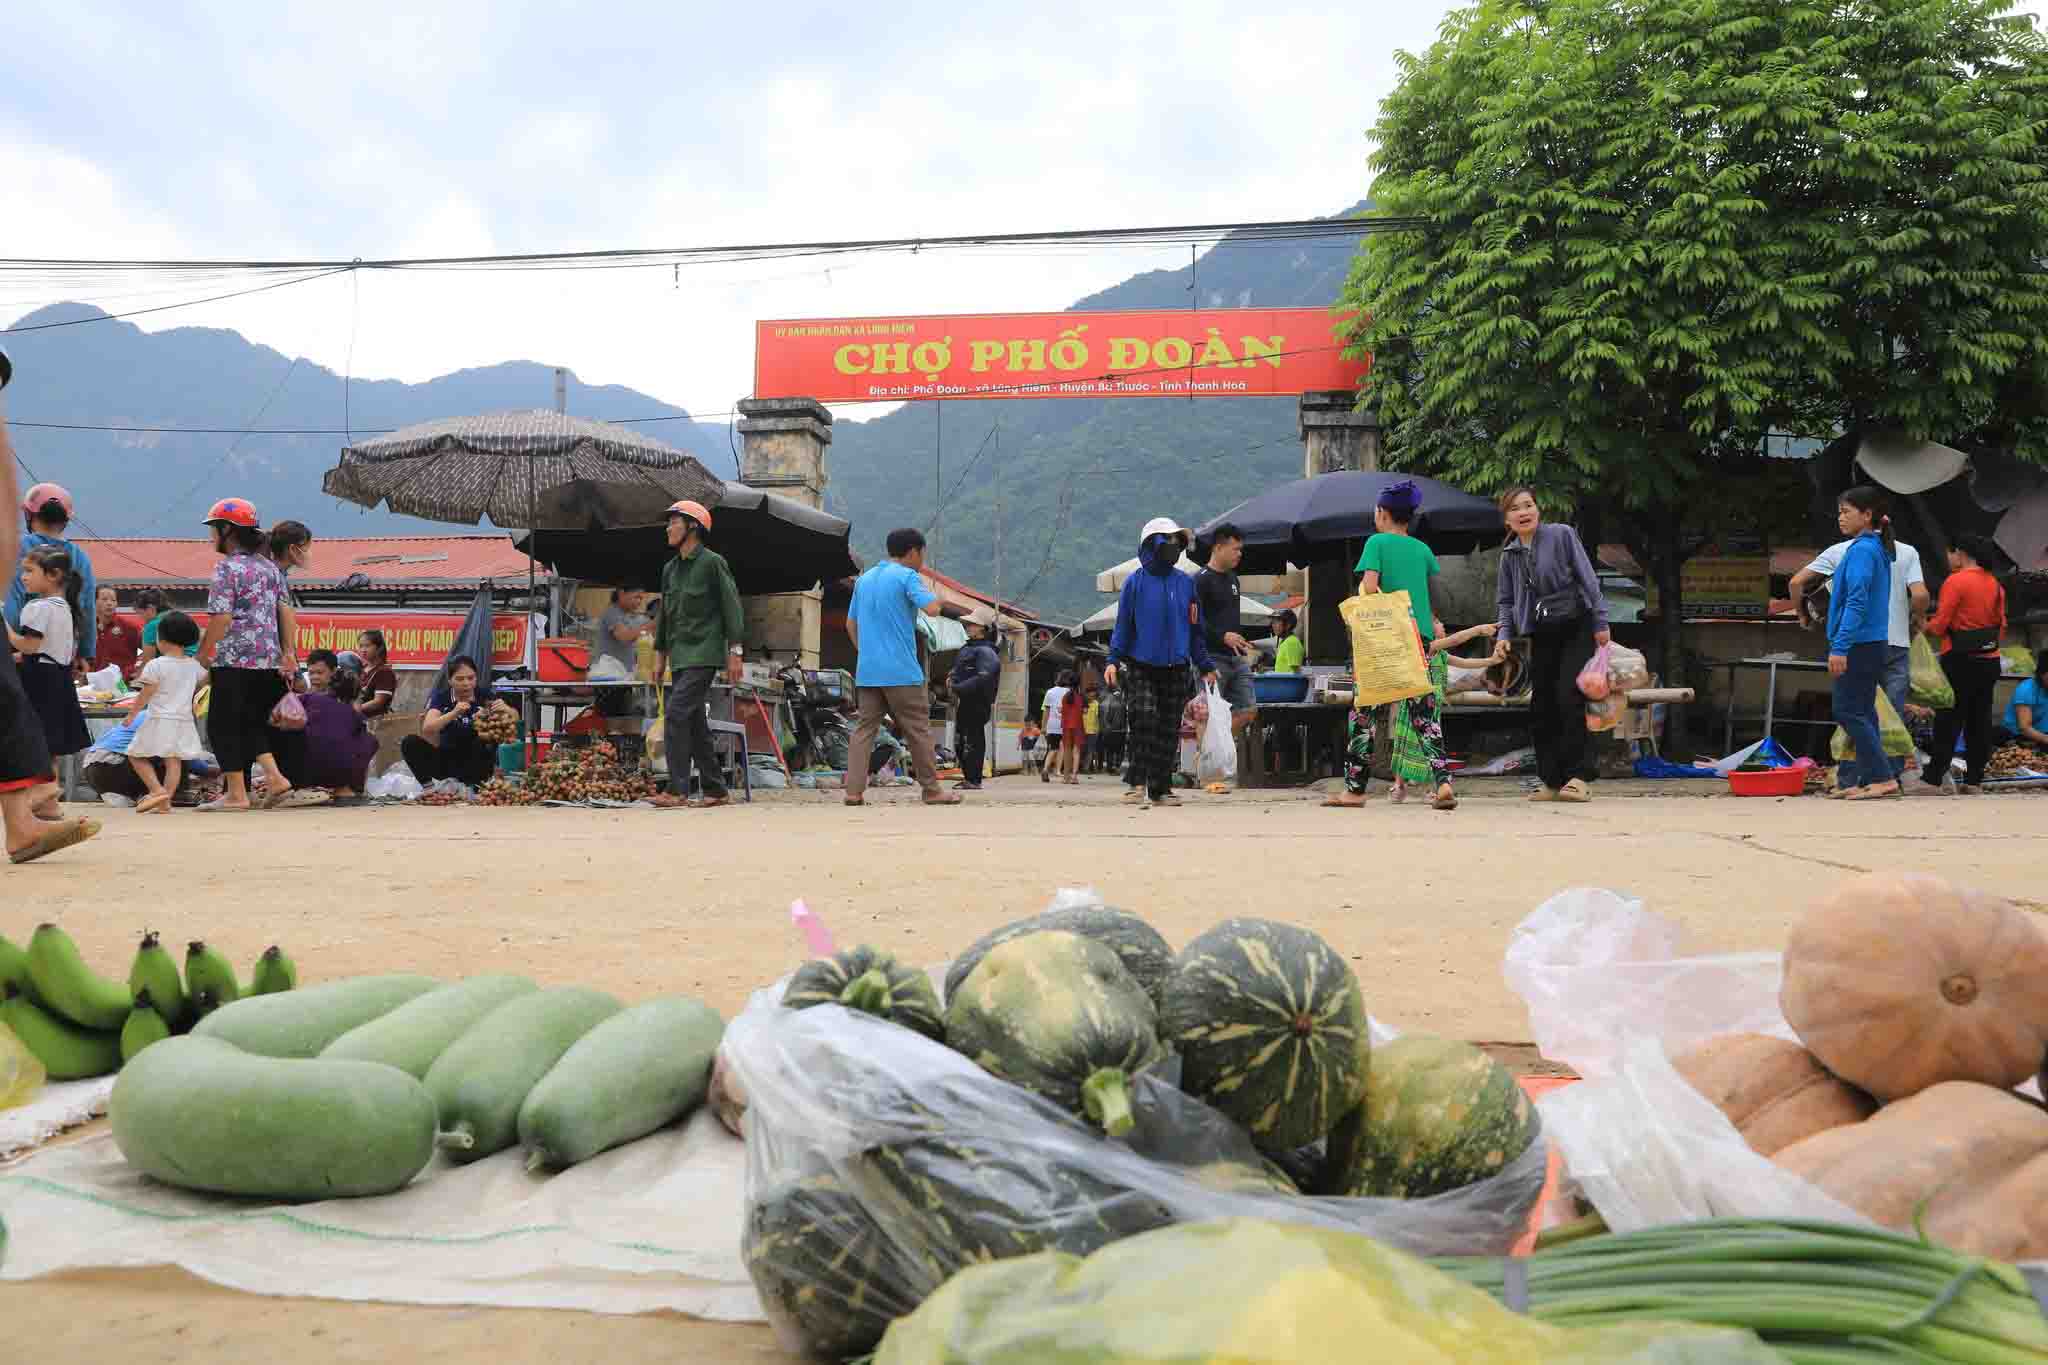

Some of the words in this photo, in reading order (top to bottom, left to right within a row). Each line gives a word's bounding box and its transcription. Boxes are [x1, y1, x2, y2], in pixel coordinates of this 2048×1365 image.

[834, 336, 953, 381] CHỢ
[969, 323, 1089, 372] PHỐ
[1107, 327, 1285, 369] ĐOÀN
[913, 384, 934, 394] Phố
[1185, 380, 1219, 391] Thanh
[395, 629, 421, 656] LOẠI
